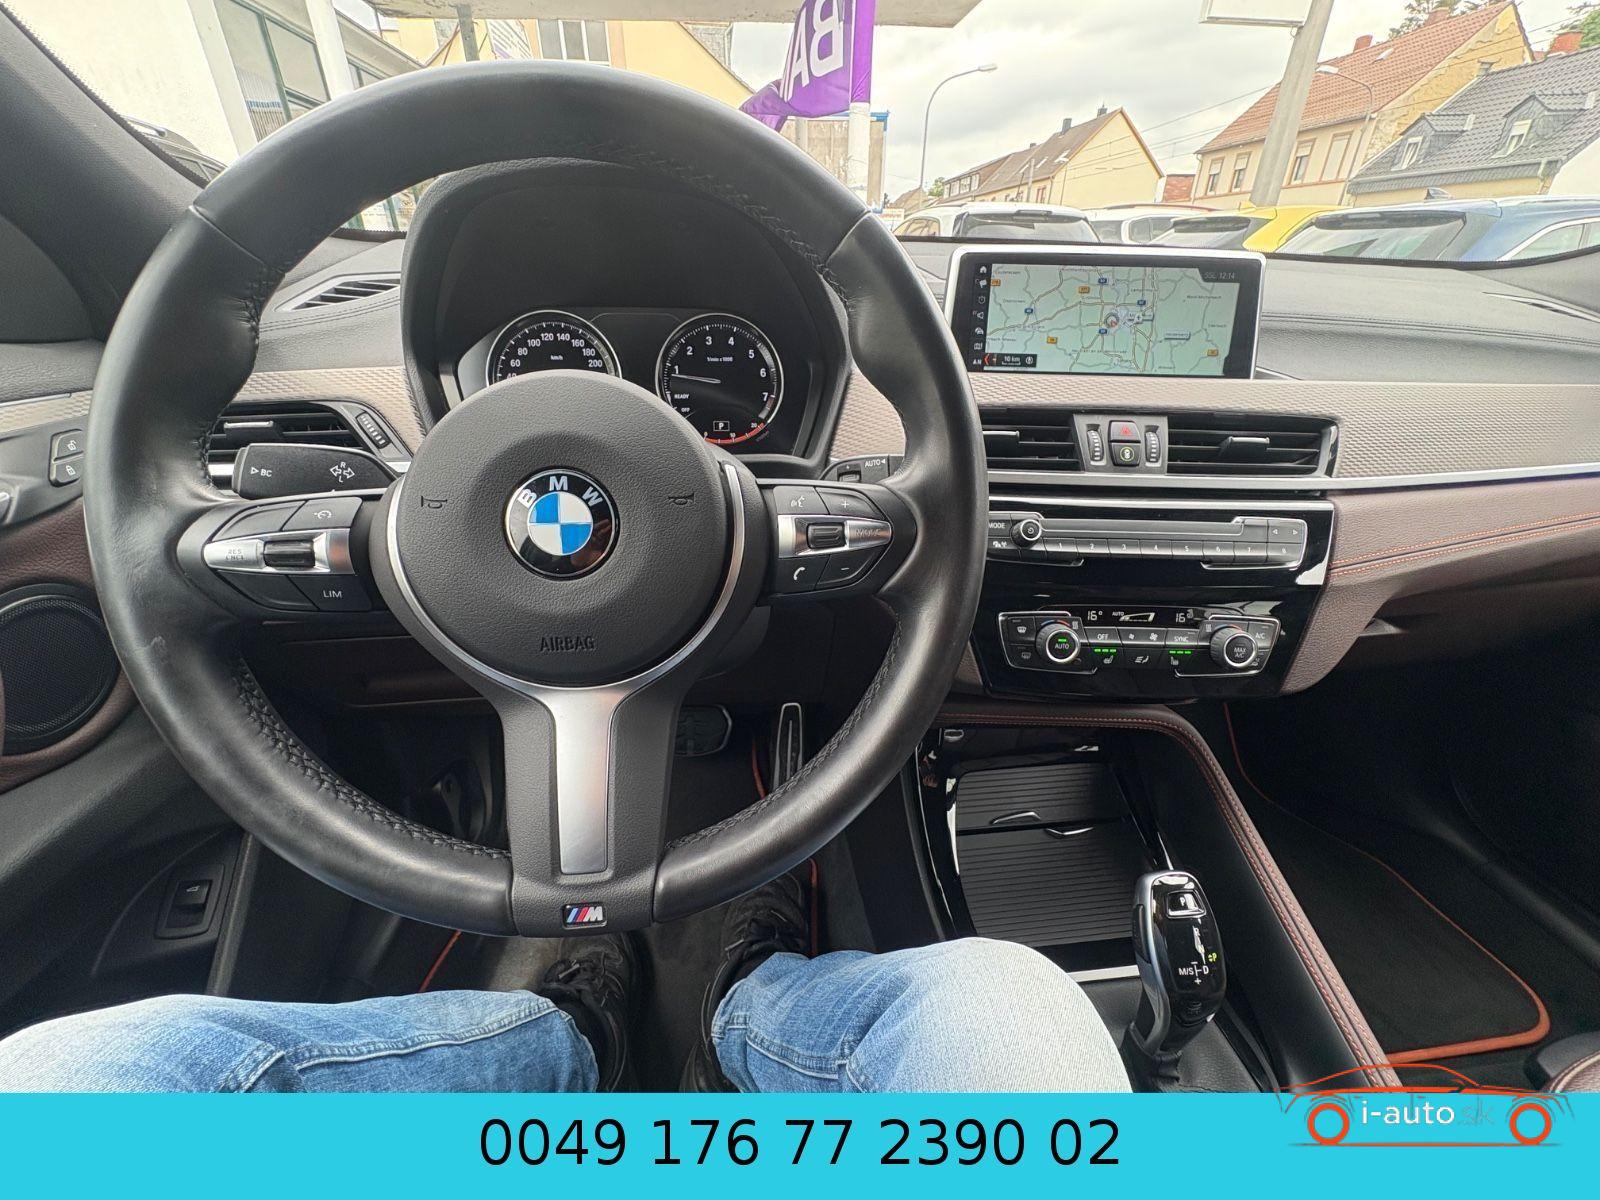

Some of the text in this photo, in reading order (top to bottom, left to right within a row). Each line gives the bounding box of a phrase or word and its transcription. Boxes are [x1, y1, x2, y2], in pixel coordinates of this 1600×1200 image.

[705, 336, 712, 345] 3
[728, 336, 734, 346] 4
[686, 346, 693, 355] 2
[748, 350, 755, 359] 5
[674, 365, 679, 374] 1
[760, 368, 766, 377] 6
[762, 392, 768, 401] 7
[864, 459, 881, 468] AUTO
[260, 468, 272, 477] BC
[518, 476, 603, 509] BMW
[323, 590, 342, 598] LIM
[540, 636, 595, 651] AIRBAG
[1179, 897, 1186, 906] P
[1178, 965, 1209, 975] M/S D
